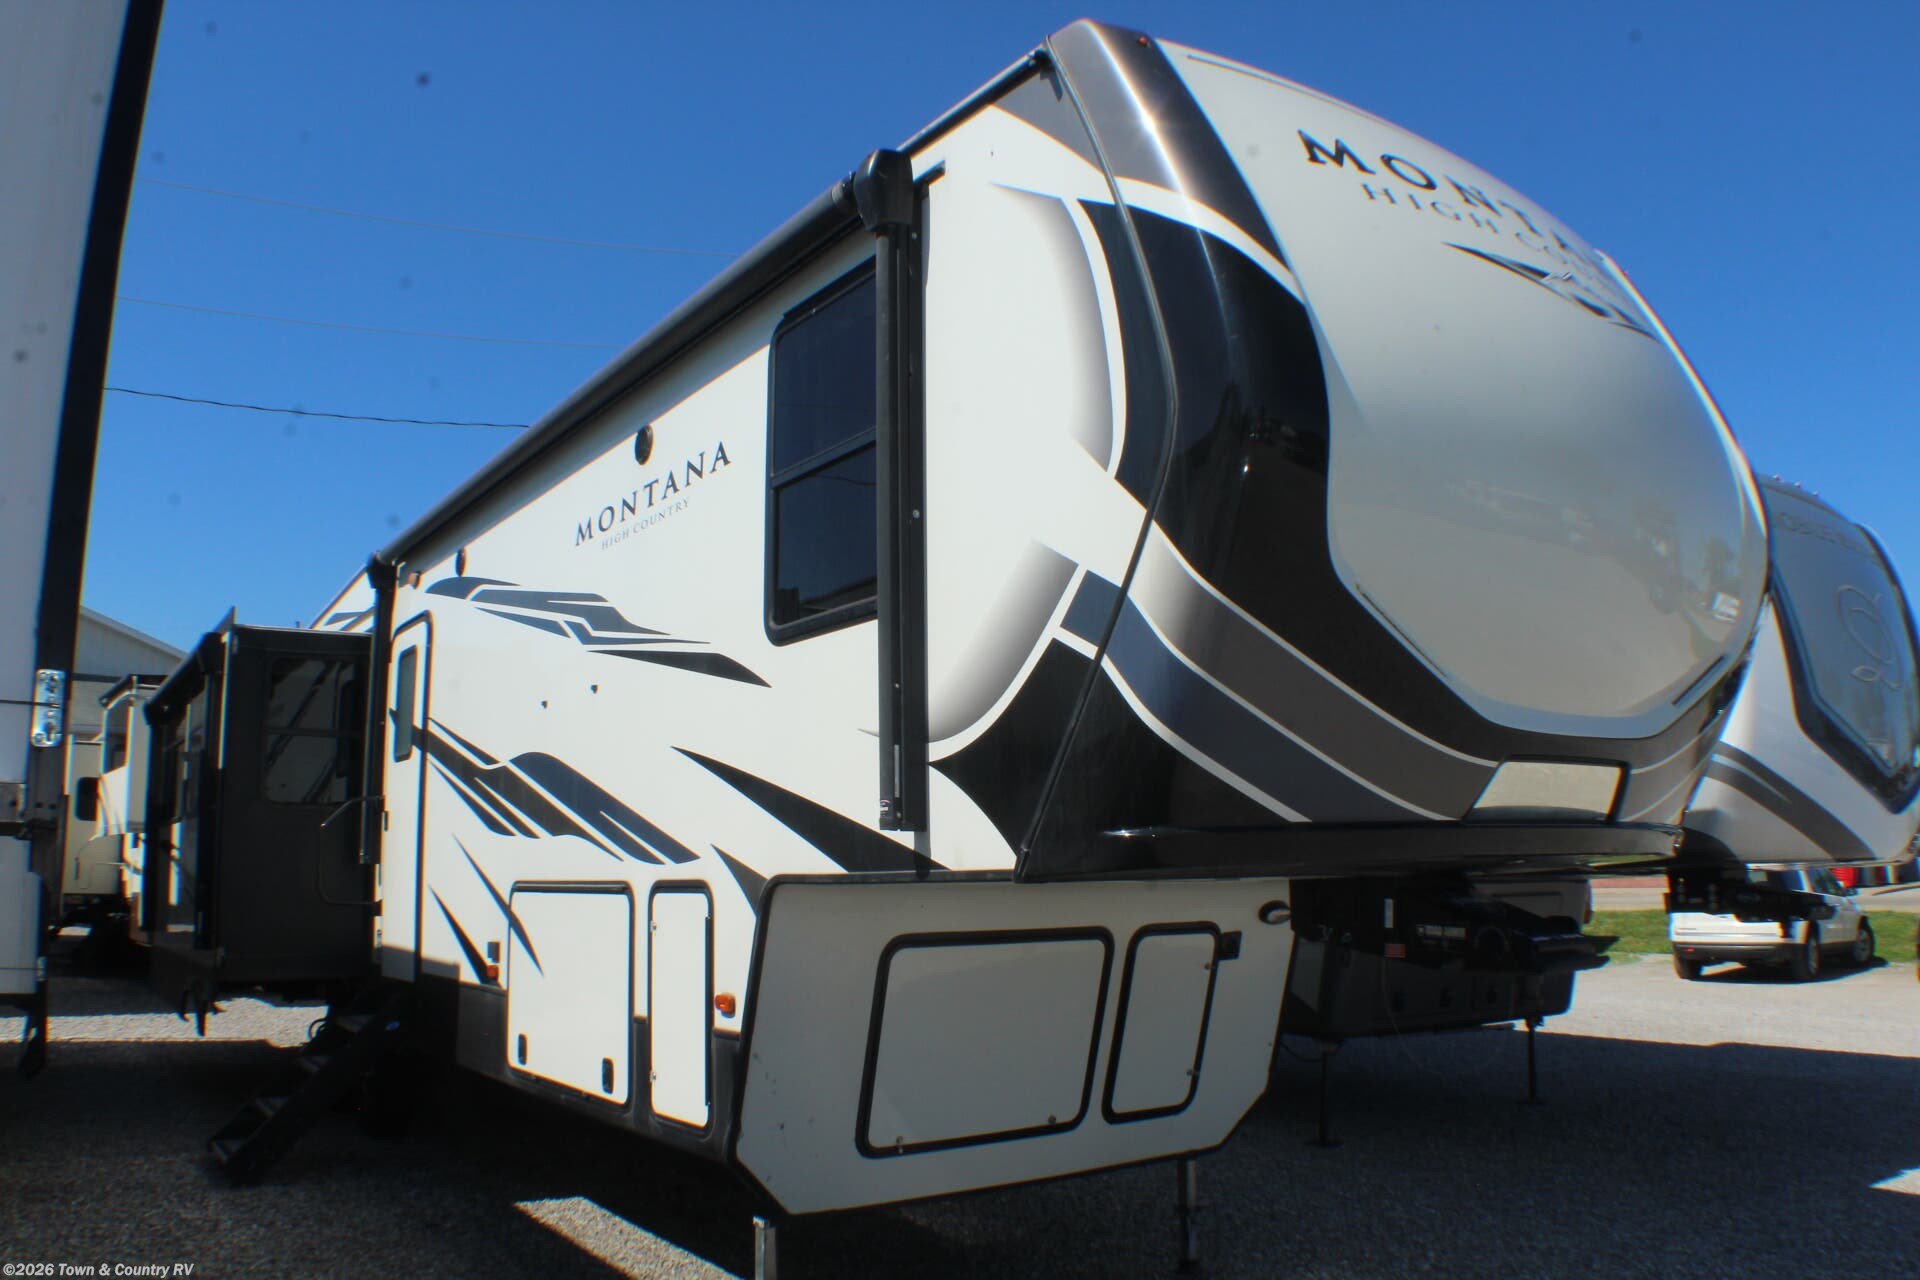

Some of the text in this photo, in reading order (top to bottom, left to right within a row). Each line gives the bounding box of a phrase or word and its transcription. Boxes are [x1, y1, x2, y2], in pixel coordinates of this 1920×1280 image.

[574, 440, 732, 547] MONTANA
[601, 496, 690, 550] HIGH COUNTRY
